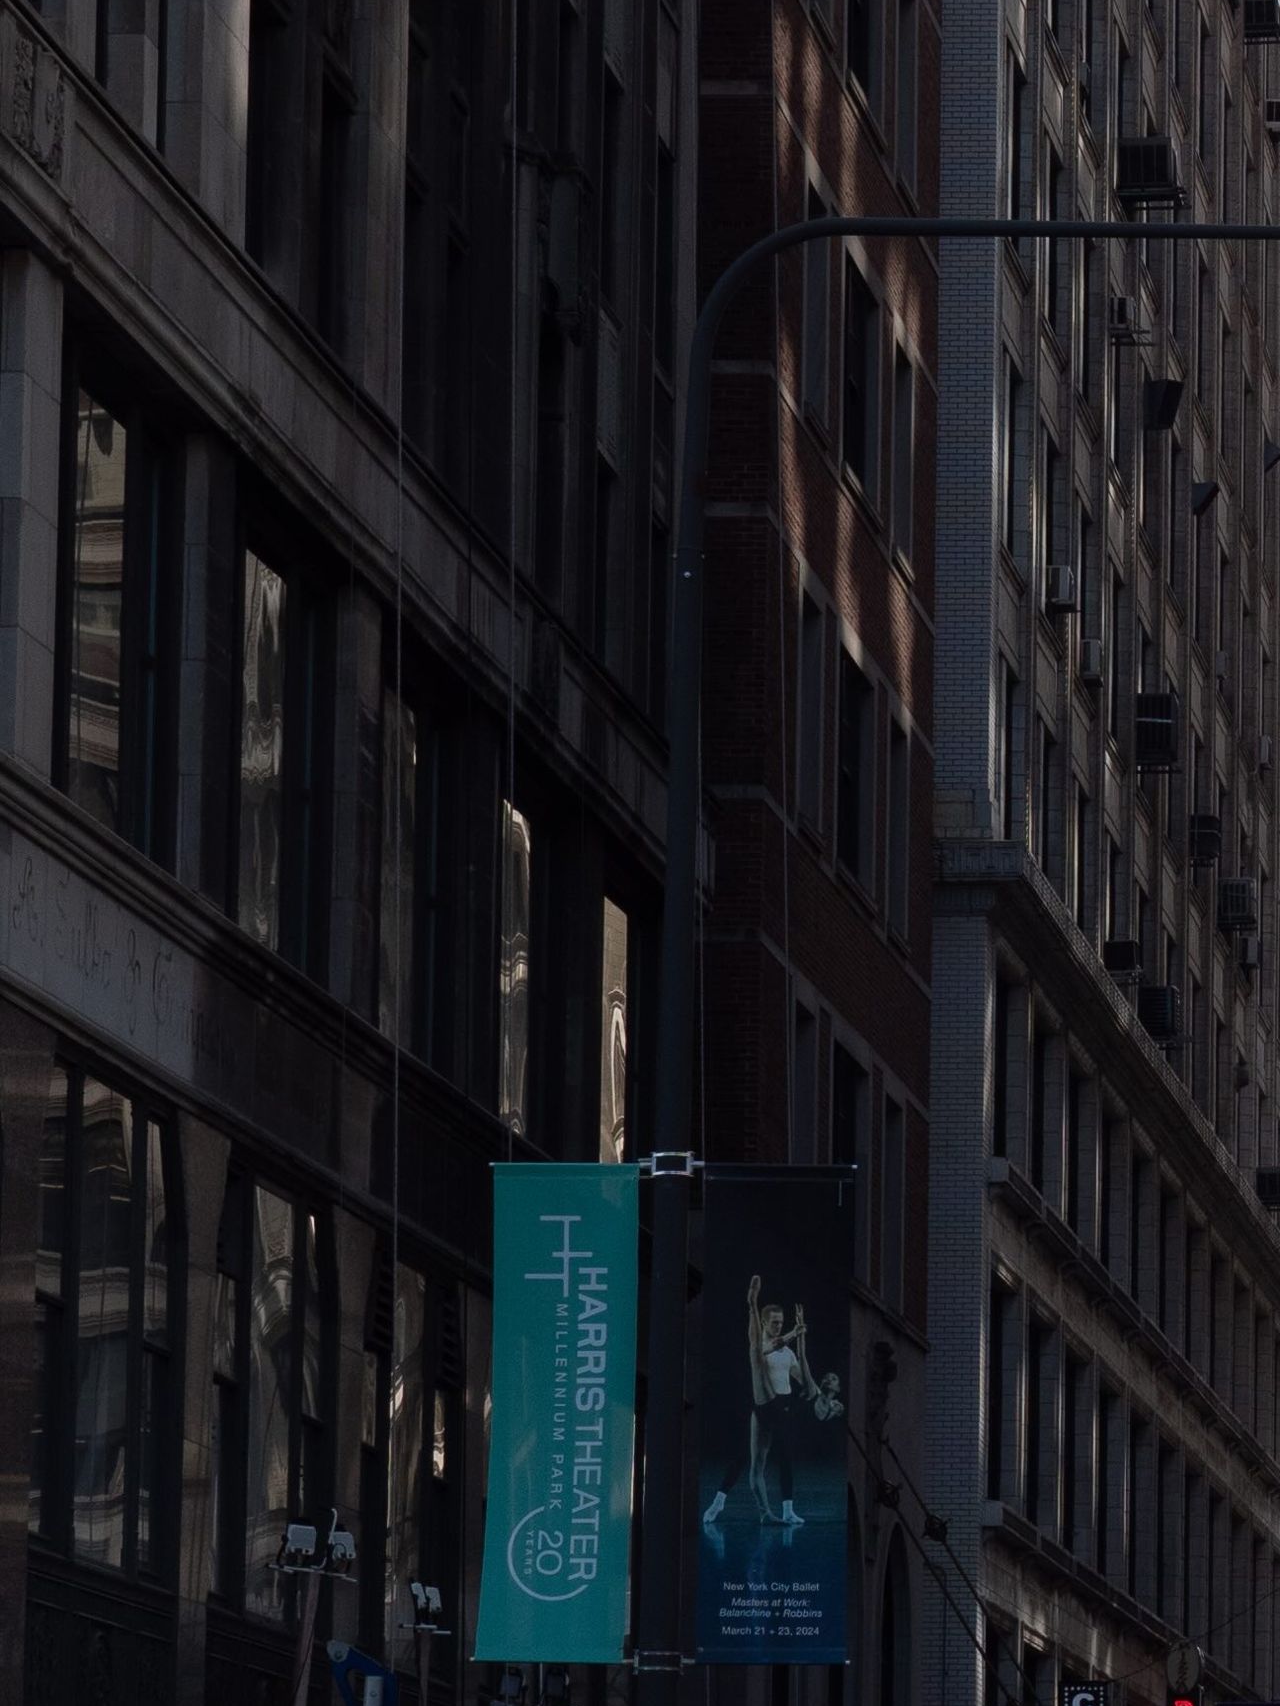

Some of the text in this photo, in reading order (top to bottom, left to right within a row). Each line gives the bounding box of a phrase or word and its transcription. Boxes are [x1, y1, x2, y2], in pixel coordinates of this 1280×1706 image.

[549, 1303, 569, 1511] MILLENNIUM PARK
[567, 1266, 609, 1582] HARRIS THEATER
[524, 1529, 534, 1576] YEARS
[535, 1529, 564, 1576] 20
[723, 1581, 820, 1594] New York City Ballet
[731, 1596, 769, 1607] Masters
[771, 1597, 781, 1607] at
[719, 1607, 772, 1618] Balanchine
[782, 1608, 823, 1618] Robbins
[721, 1626, 752, 1636] March
[753, 1626, 766, 1636] 21
[777, 1626, 793, 1637] 23,
[795, 1626, 820, 1636] 2024
